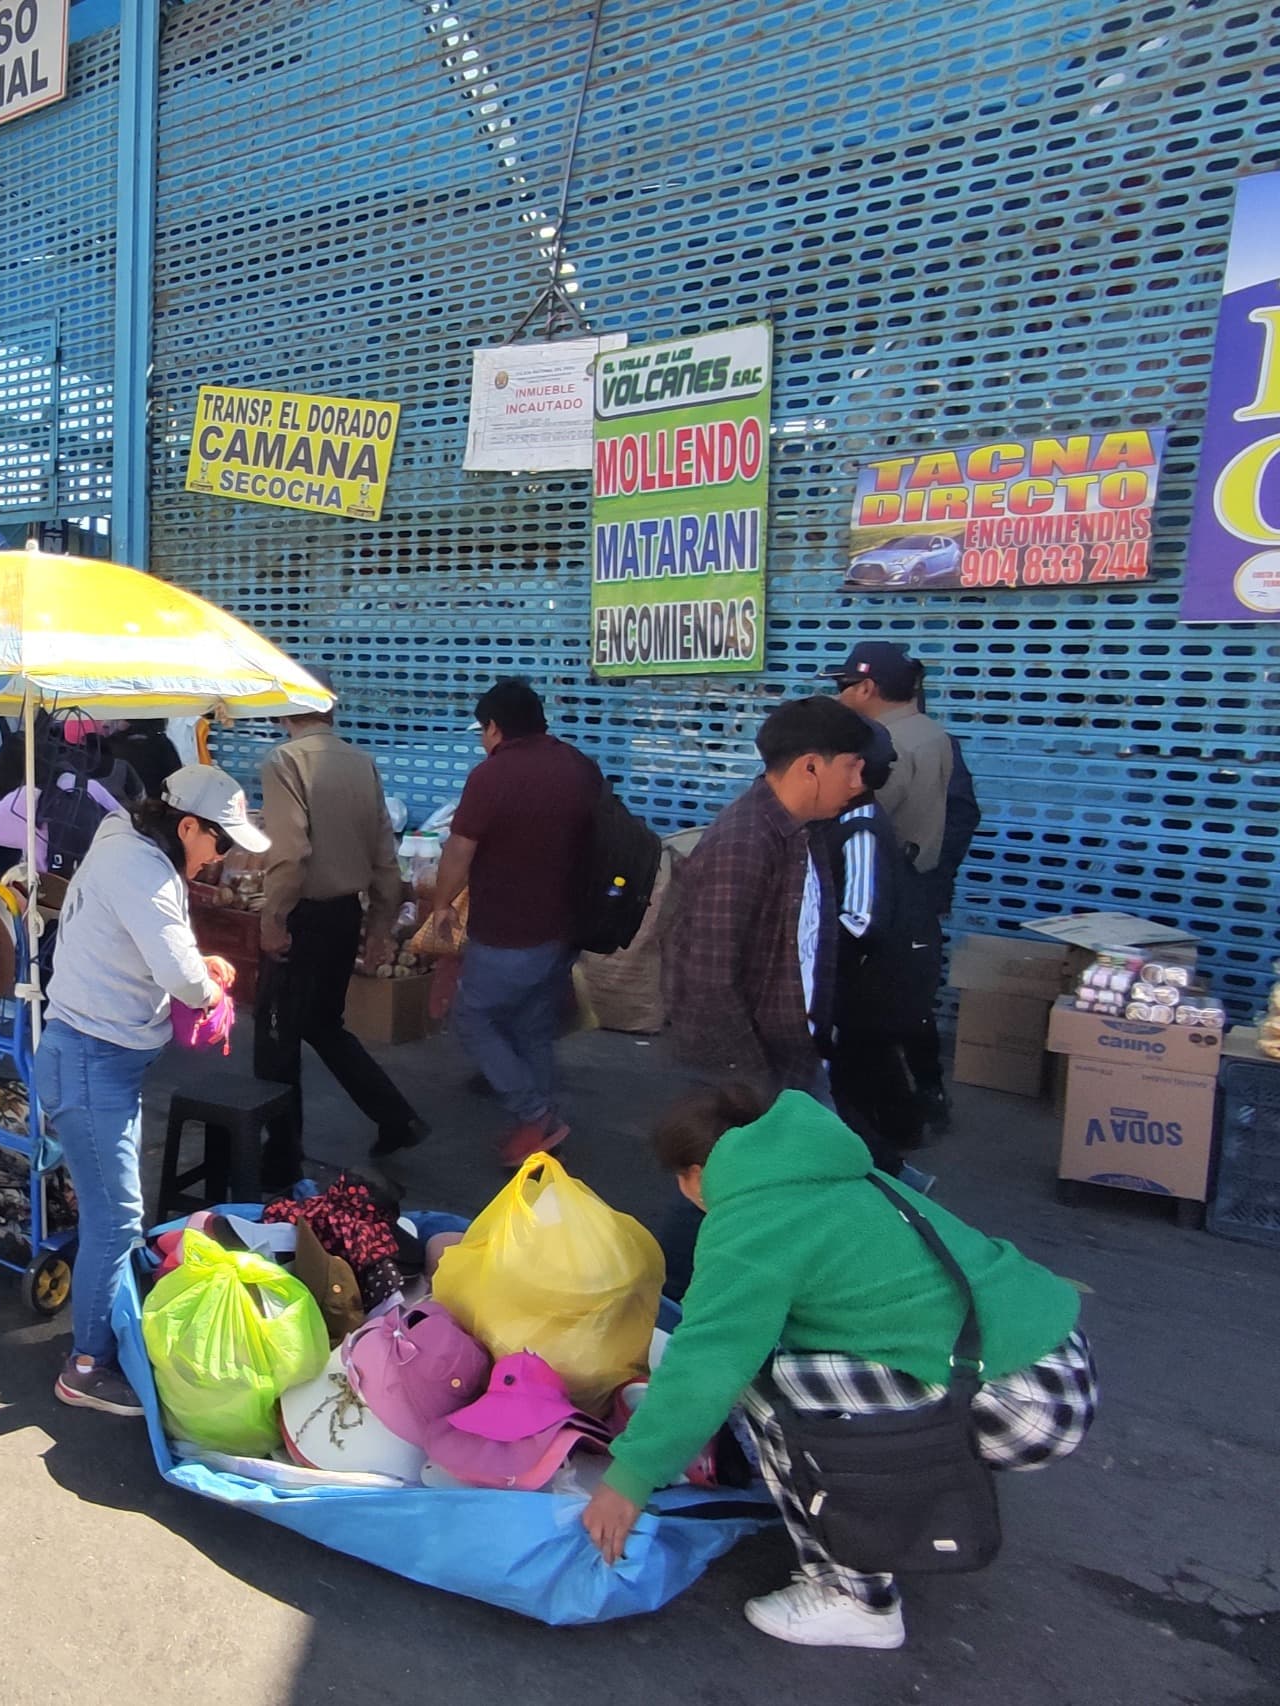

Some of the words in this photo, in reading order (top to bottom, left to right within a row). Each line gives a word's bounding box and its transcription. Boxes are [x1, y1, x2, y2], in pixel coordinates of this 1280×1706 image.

[603, 362, 615, 374] EL
[618, 355, 651, 371] VALLE
[655, 351, 670, 364] DE
[671, 347, 694, 362] LOS
[603, 356, 732, 410] VOLCANES
[505, 398, 583, 415] INCAUTADO
[515, 383, 576, 399] INMUEBLE
[203, 394, 272, 427] TRANSP.
[278, 401, 300, 431] EL
[307, 404, 392, 441] DORADO
[198, 425, 379, 484] CAMANA
[596, 416, 762, 497] MOLLENDO
[867, 430, 1156, 491] TACNA
[219, 469, 342, 509] SECOCHA
[858, 470, 1149, 526] DIRECTO
[596, 509, 759, 582] MATARANI
[964, 508, 1151, 548] ENCOMIENDAS
[960, 546, 1017, 587] 904
[1023, 544, 1084, 585] 833
[1088, 541, 1148, 580] 244
[596, 598, 756, 664] ENCOMIENDAS
[1097, 1034, 1166, 1054] casino
[1110, 1119, 1183, 1147] SODA
